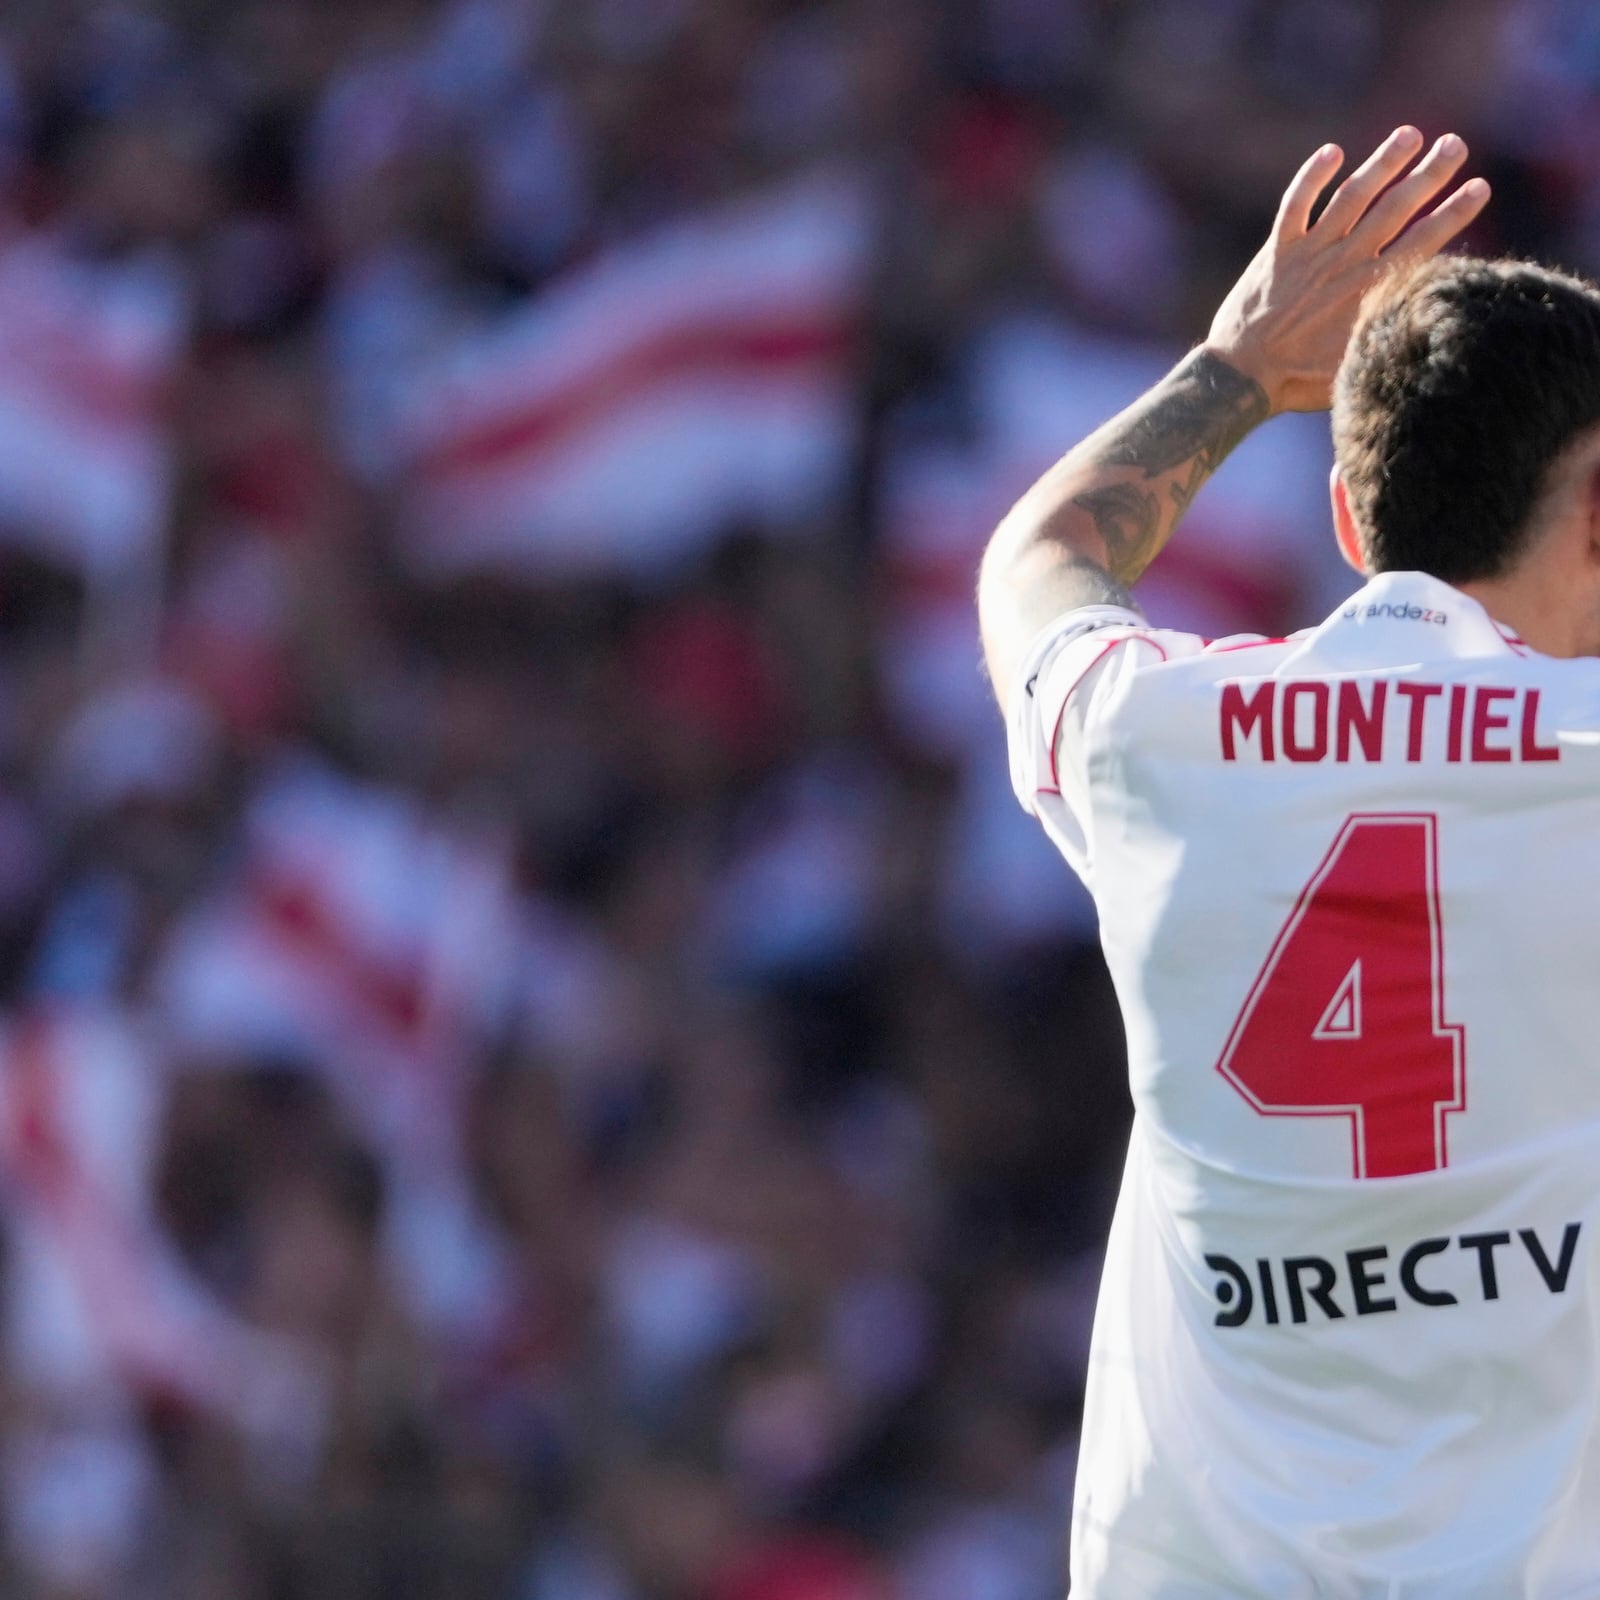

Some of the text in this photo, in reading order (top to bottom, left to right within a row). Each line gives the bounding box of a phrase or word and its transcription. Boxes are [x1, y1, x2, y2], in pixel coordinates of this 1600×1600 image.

[1220, 680, 1561, 764] MONTIEL
[1214, 812, 1466, 1180] 4
[1203, 1221, 1584, 1328] DIRECTV
